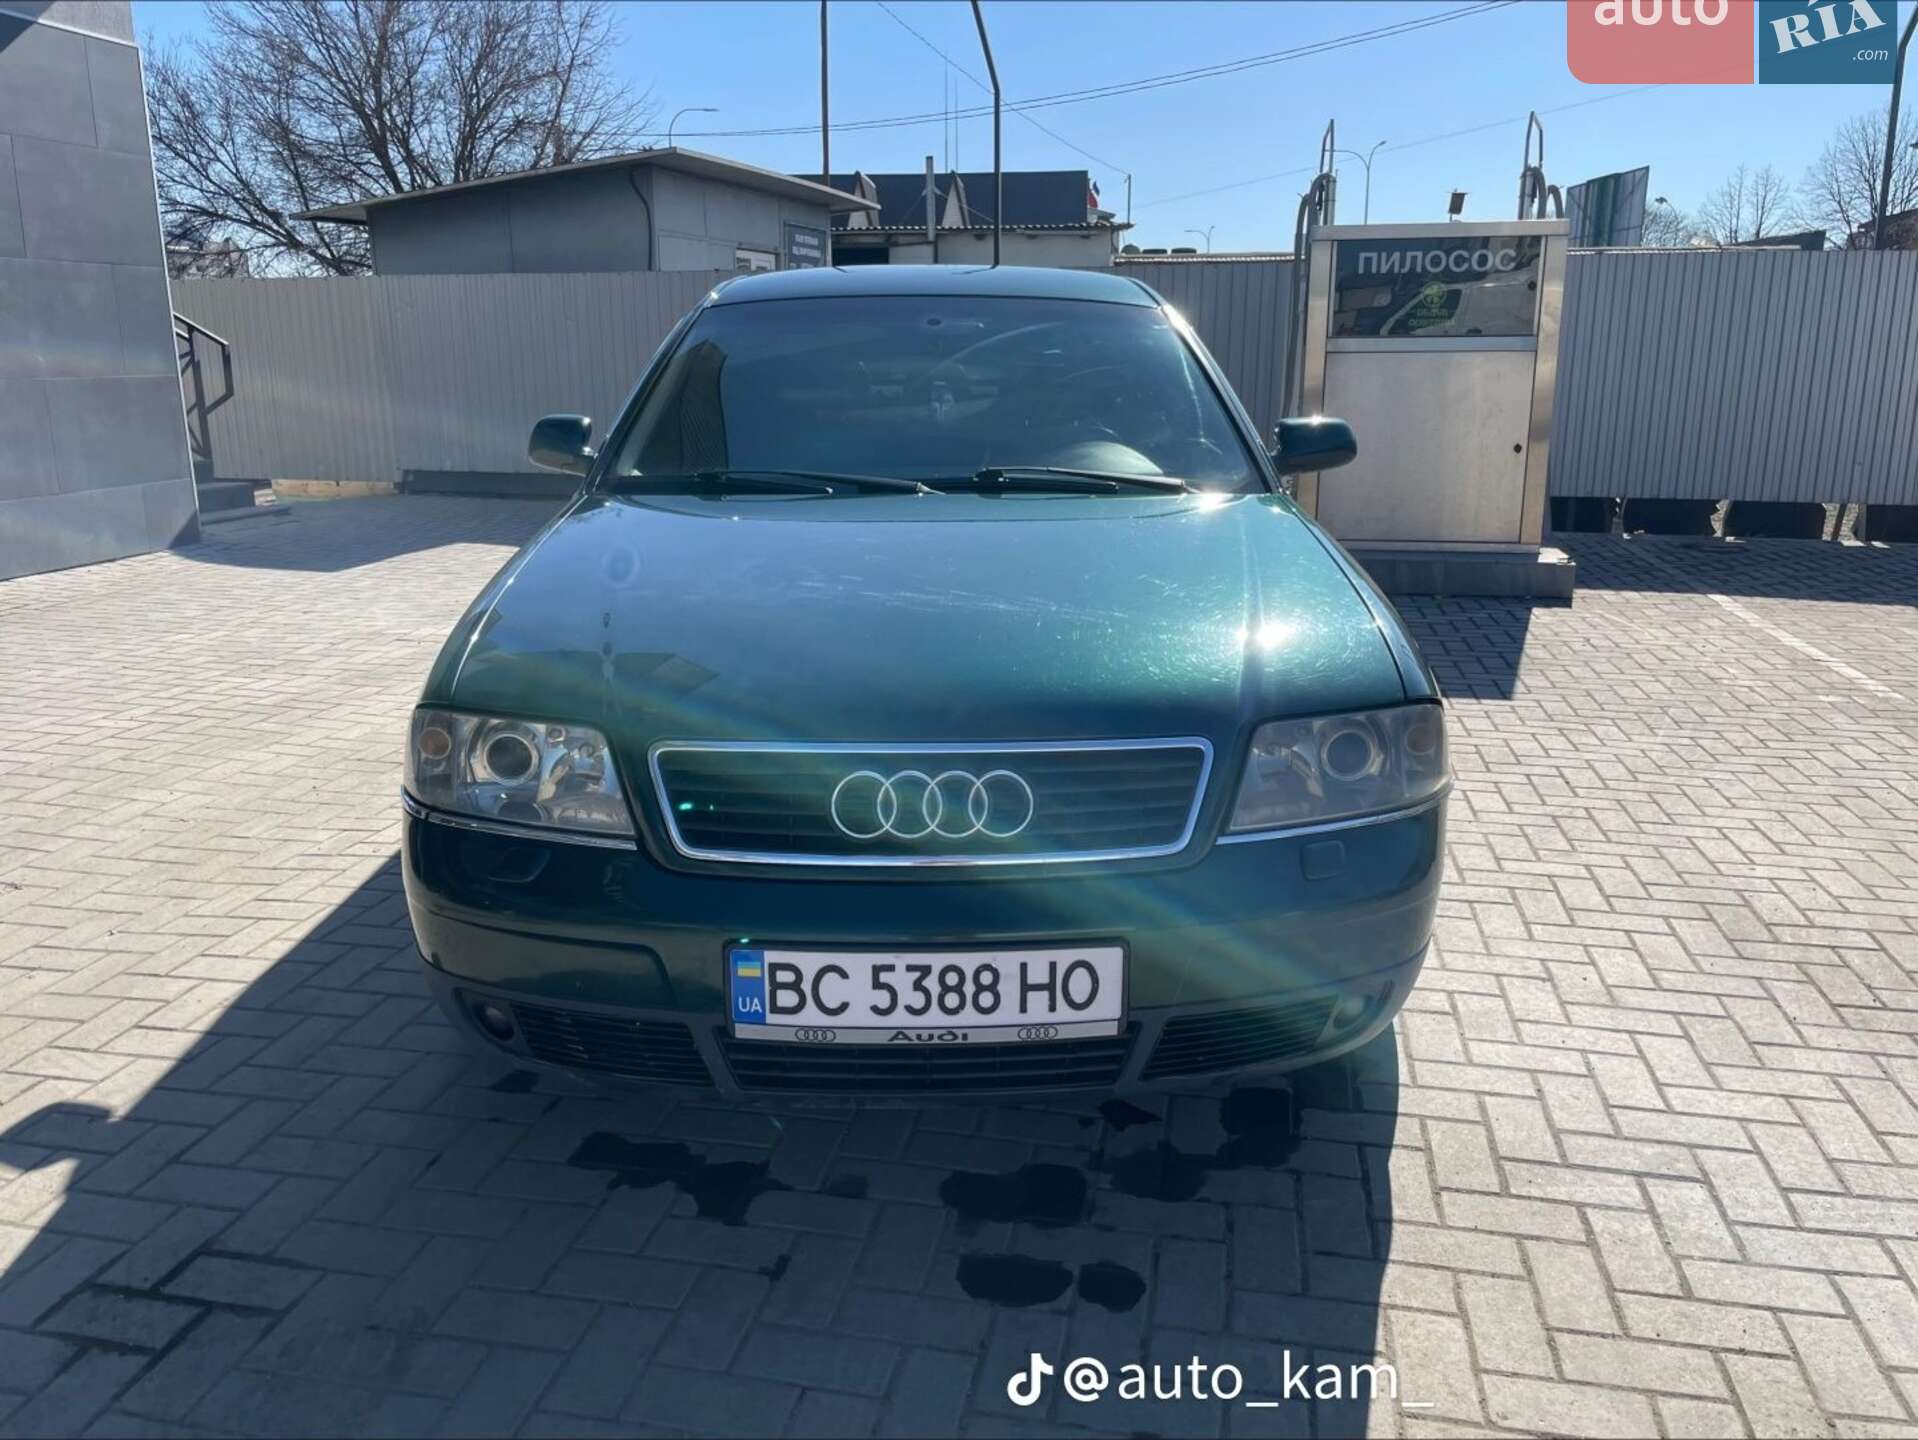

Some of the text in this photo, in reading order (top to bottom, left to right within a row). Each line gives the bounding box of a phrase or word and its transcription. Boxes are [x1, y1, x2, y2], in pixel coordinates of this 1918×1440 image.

[1358, 249, 1518, 275] ПИЛОСОС
[768, 959, 1100, 1017] BC 5388 HO
[738, 996, 763, 1014] UA
[887, 1030, 969, 1043] Audi
